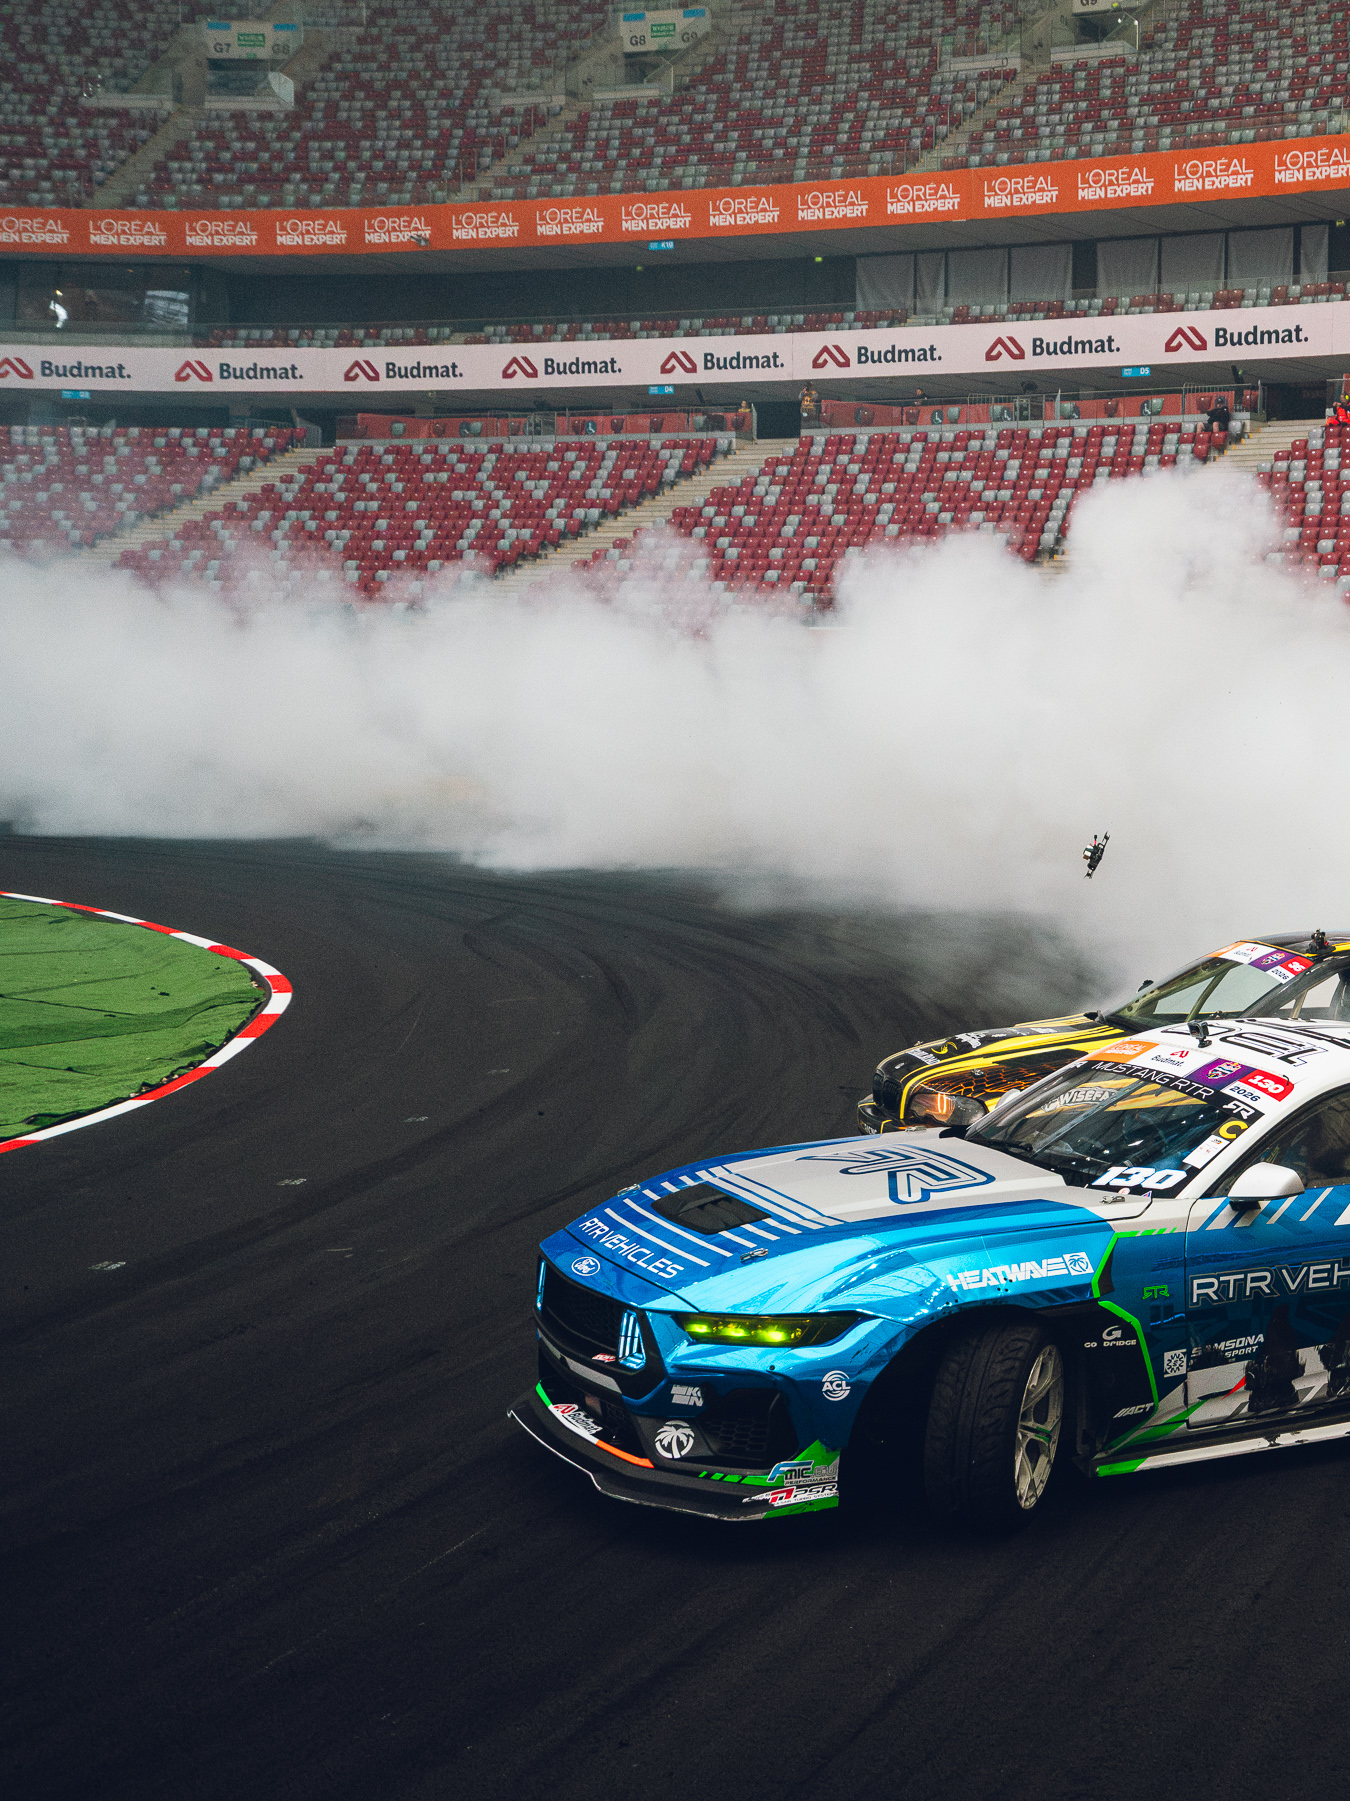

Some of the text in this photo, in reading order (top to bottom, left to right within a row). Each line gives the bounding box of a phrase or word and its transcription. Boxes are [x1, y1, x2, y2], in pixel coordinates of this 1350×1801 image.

[213, 42, 231, 53] G7
[630, 35, 646, 46] G8
[1175, 158, 1254, 179] L'ORÉAL
[1275, 169, 1303, 183] MEN
[985, 175, 1058, 197] L'ORÉAL
[1078, 167, 1154, 190] L'ORÉAL
[1175, 174, 1253, 192] MEN EXPERT
[798, 190, 868, 209] L'ORÉAL
[887, 183, 960, 203] L'ORÉAL
[985, 191, 1058, 208] MEN EXPERT
[1078, 182, 1154, 200] MEN EXPERT
[622, 202, 691, 222] L'ORÉAL
[710, 196, 779, 215] L'ORÉAL
[798, 205, 868, 220] MEN EXPERT
[887, 198, 960, 214] MEN EXPERT
[365, 216, 431, 232] L'ORÉAL
[453, 212, 519, 230] L'ORÉAL
[537, 207, 604, 224] L'ORÉAL
[622, 217, 691, 231] MEN EXPERT
[710, 211, 779, 226] MEN EXPERT
[90, 219, 166, 234] L'ORÉAL
[186, 220, 257, 235] L'ORÉAL
[277, 219, 347, 236] L'ORÉAL
[453, 226, 519, 239] MEN EXPERT
[537, 222, 604, 235] MEN EXPERT
[21, 233, 69, 243] EXPERT
[90, 234, 166, 245] MEN EXPERT
[186, 235, 258, 245] MEN EXPERT
[277, 234, 347, 245] MEN EXPERT
[365, 232, 389, 243] MEN
[1214, 325, 1309, 347] Budmat.
[857, 345, 942, 364] Budmat.
[1032, 336, 1120, 357] Budmat.
[41, 360, 131, 380] Budmat.
[385, 361, 463, 379] Budmat.
[543, 357, 622, 375] Budmat.
[703, 352, 784, 370] Budmat.
[220, 362, 303, 380] Budmat.
[1091, 1061, 1215, 1100] MUSTANG RTR
[1248, 1075, 1285, 1094] 130
[1229, 1085, 1261, 1102] 2026
[1219, 1120, 1248, 1139] C
[1091, 1166, 1187, 1190] 130
[579, 1217, 685, 1279] RTR VEHICLES
[946, 1258, 1069, 1292] HEATWAVE
[1193, 1270, 1273, 1303] RTR
[822, 1381, 851, 1392] ACL
[785, 1476, 837, 1486] PERFORMANCE
[793, 1484, 837, 1498] PSR
